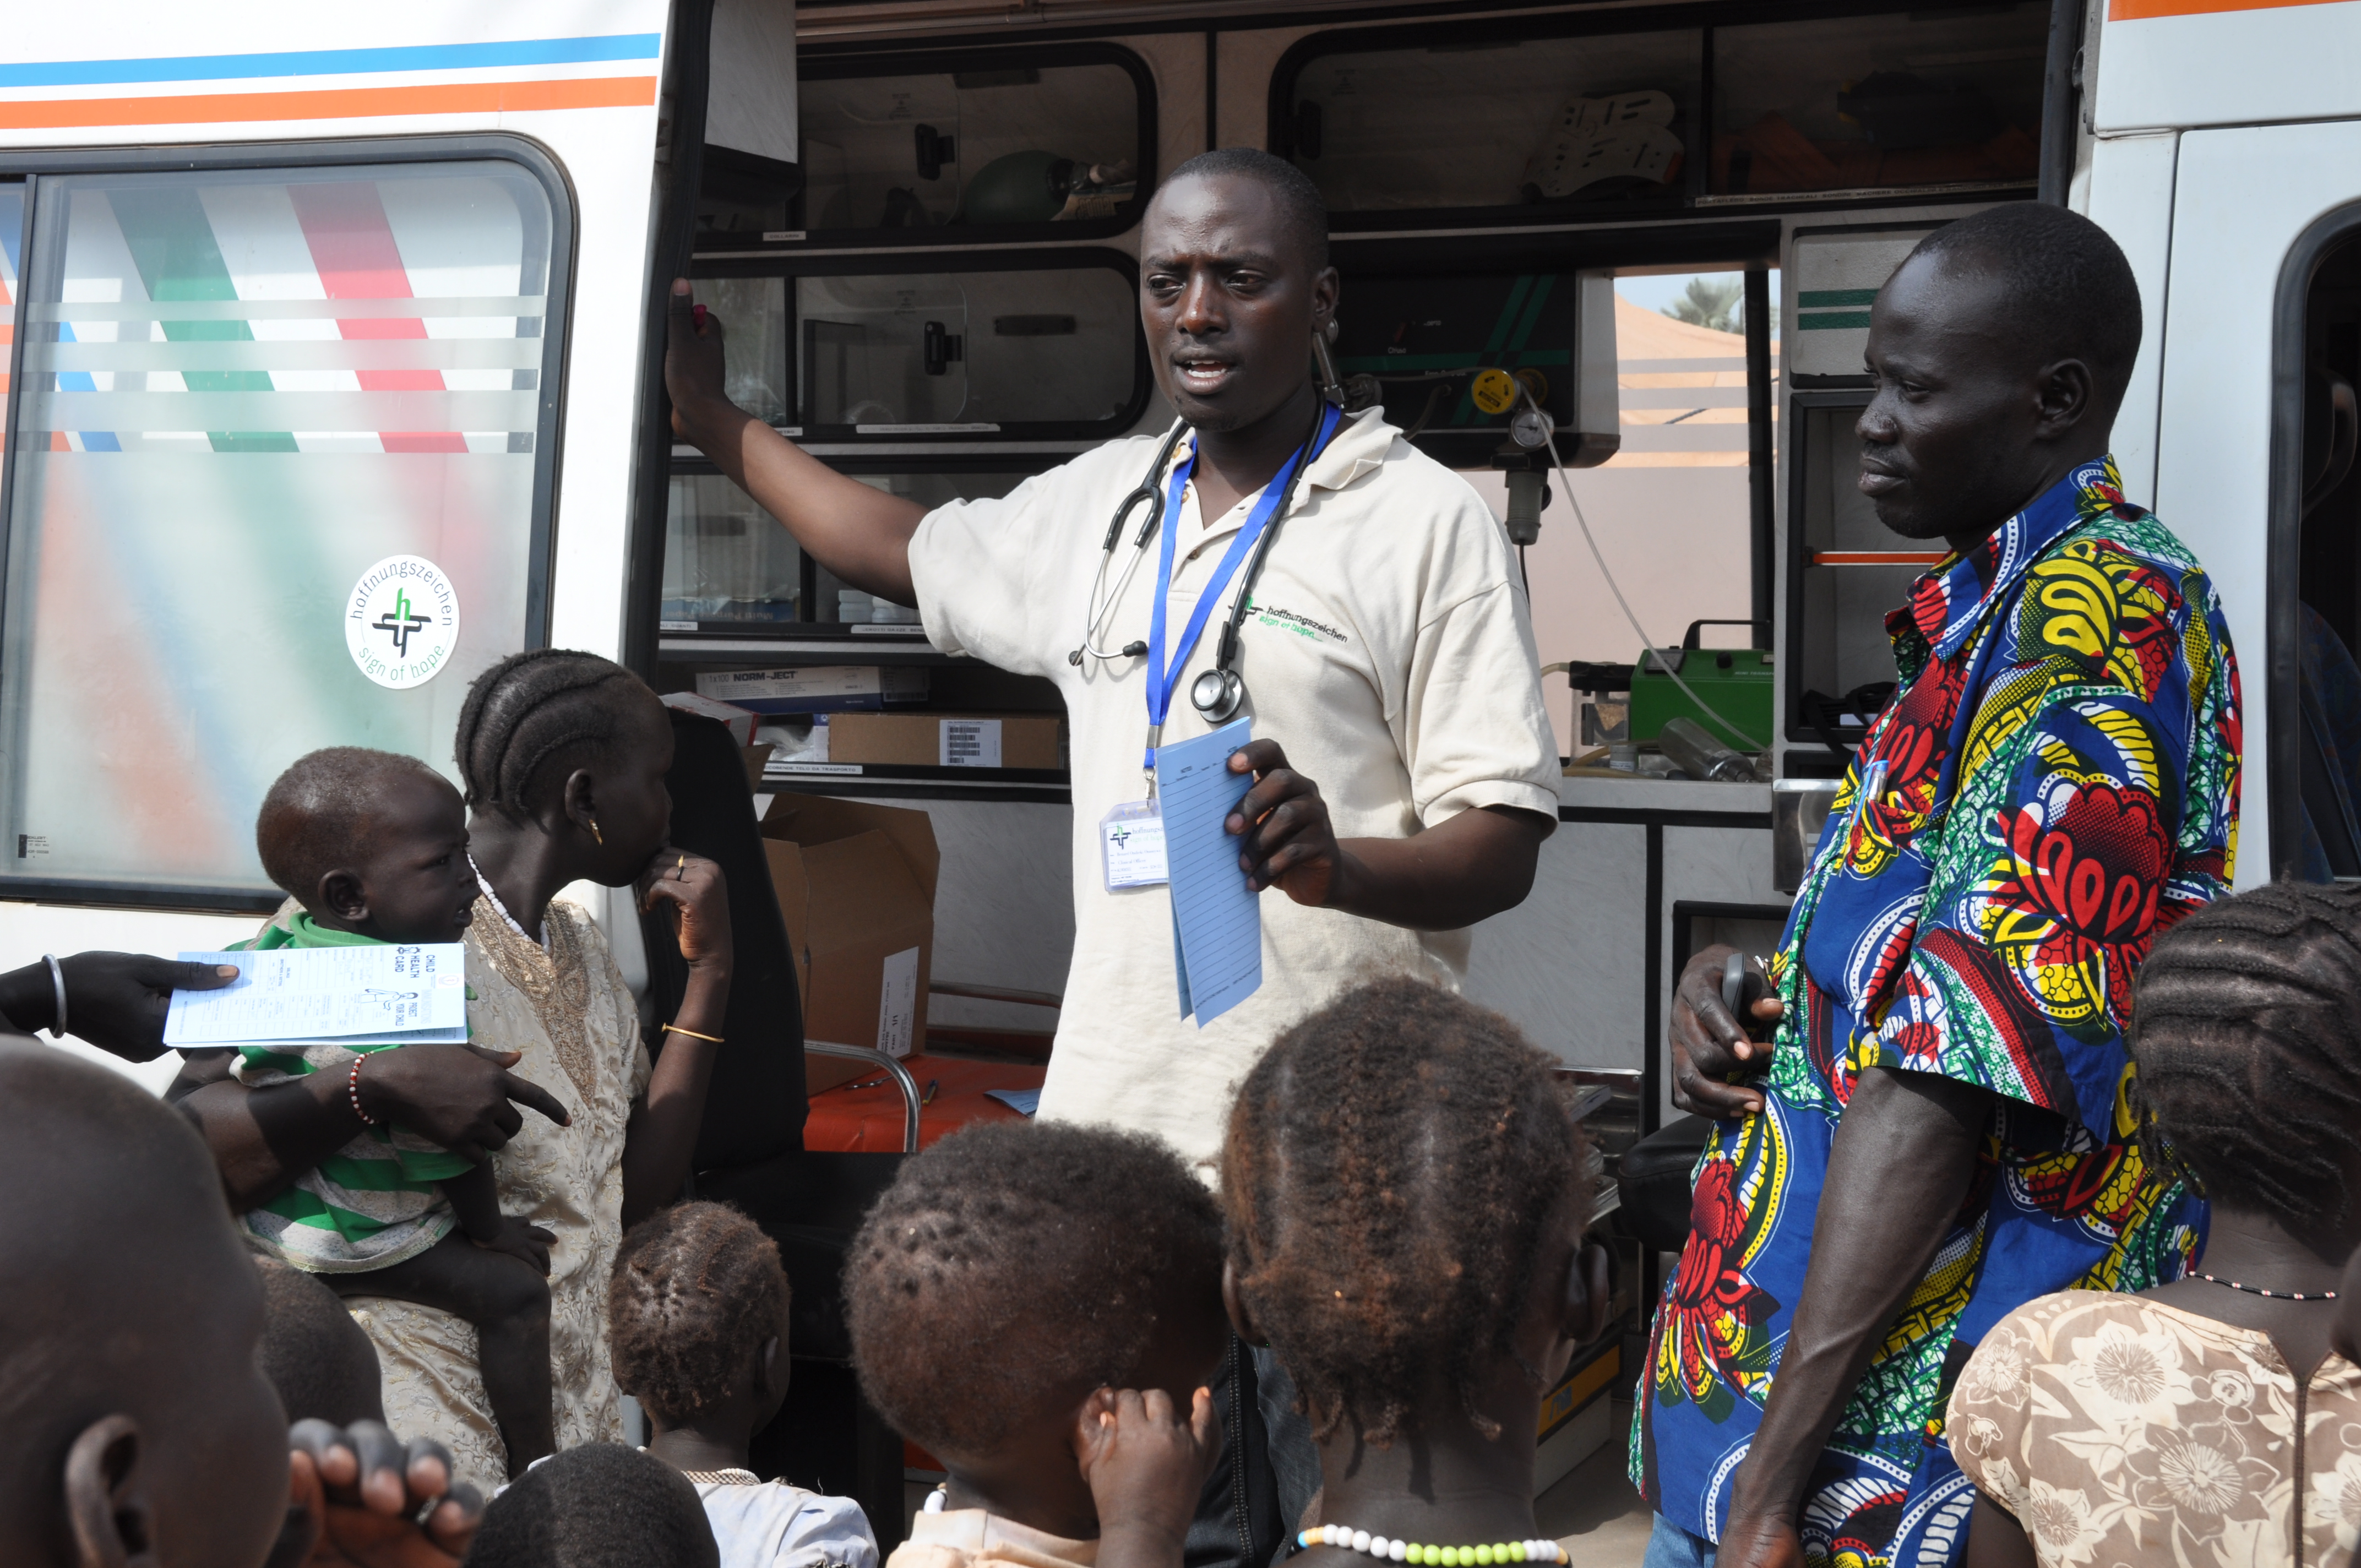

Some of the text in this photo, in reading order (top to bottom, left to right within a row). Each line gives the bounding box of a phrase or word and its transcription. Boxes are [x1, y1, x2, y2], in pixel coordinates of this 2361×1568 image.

[350, 560, 452, 626] hoffnungszeichen
[1267, 606, 1348, 643] hoffnungszeichen
[359, 645, 444, 680] sign of hope
[733, 671, 796, 682] NORM-JECT
[395, 956, 405, 973] CARD
[410, 955, 420, 978] HEALTH
[426, 955, 436, 973] CHILD
[395, 1014, 405, 1026] CHILD
